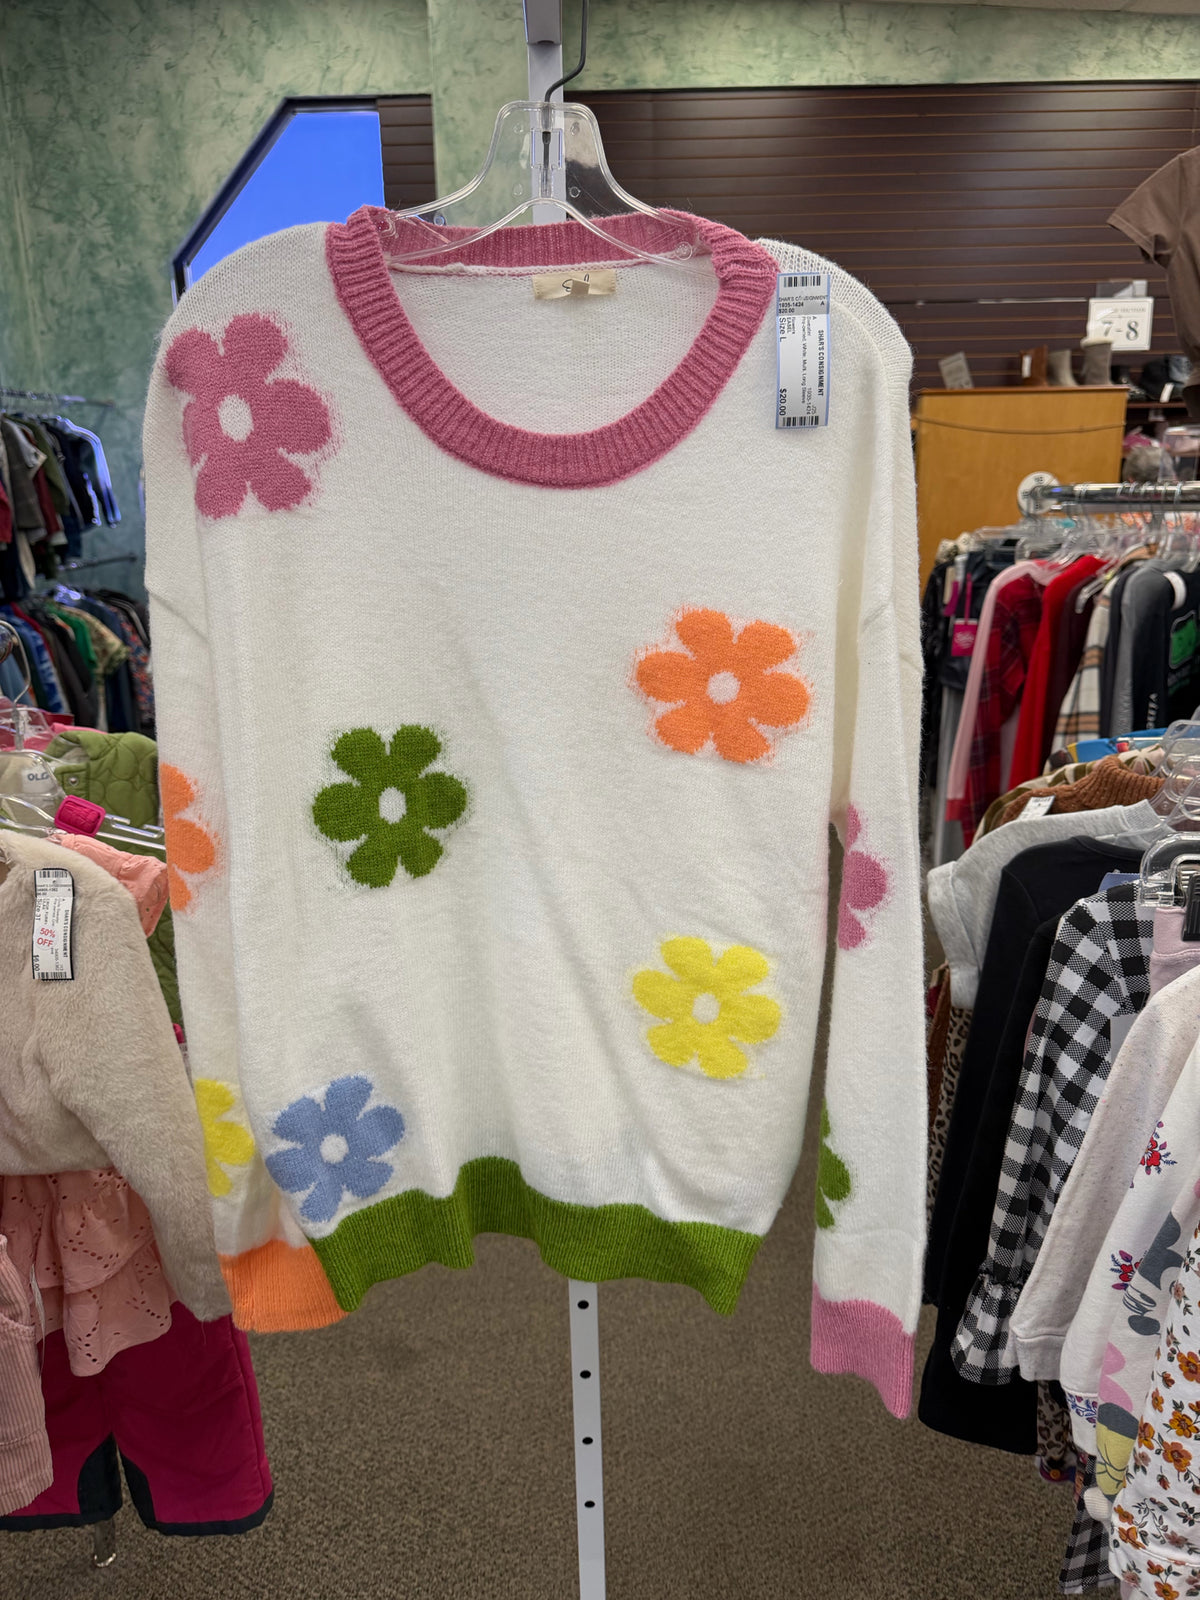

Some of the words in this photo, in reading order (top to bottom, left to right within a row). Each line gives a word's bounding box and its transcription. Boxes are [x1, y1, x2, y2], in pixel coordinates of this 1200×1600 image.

[779, 317, 787, 335] Size
[817, 351, 825, 397] CONSIGNMENT
[779, 388, 787, 416] $20.00
[39, 927, 56, 938] 50%
[37, 937, 54, 947] OFF
